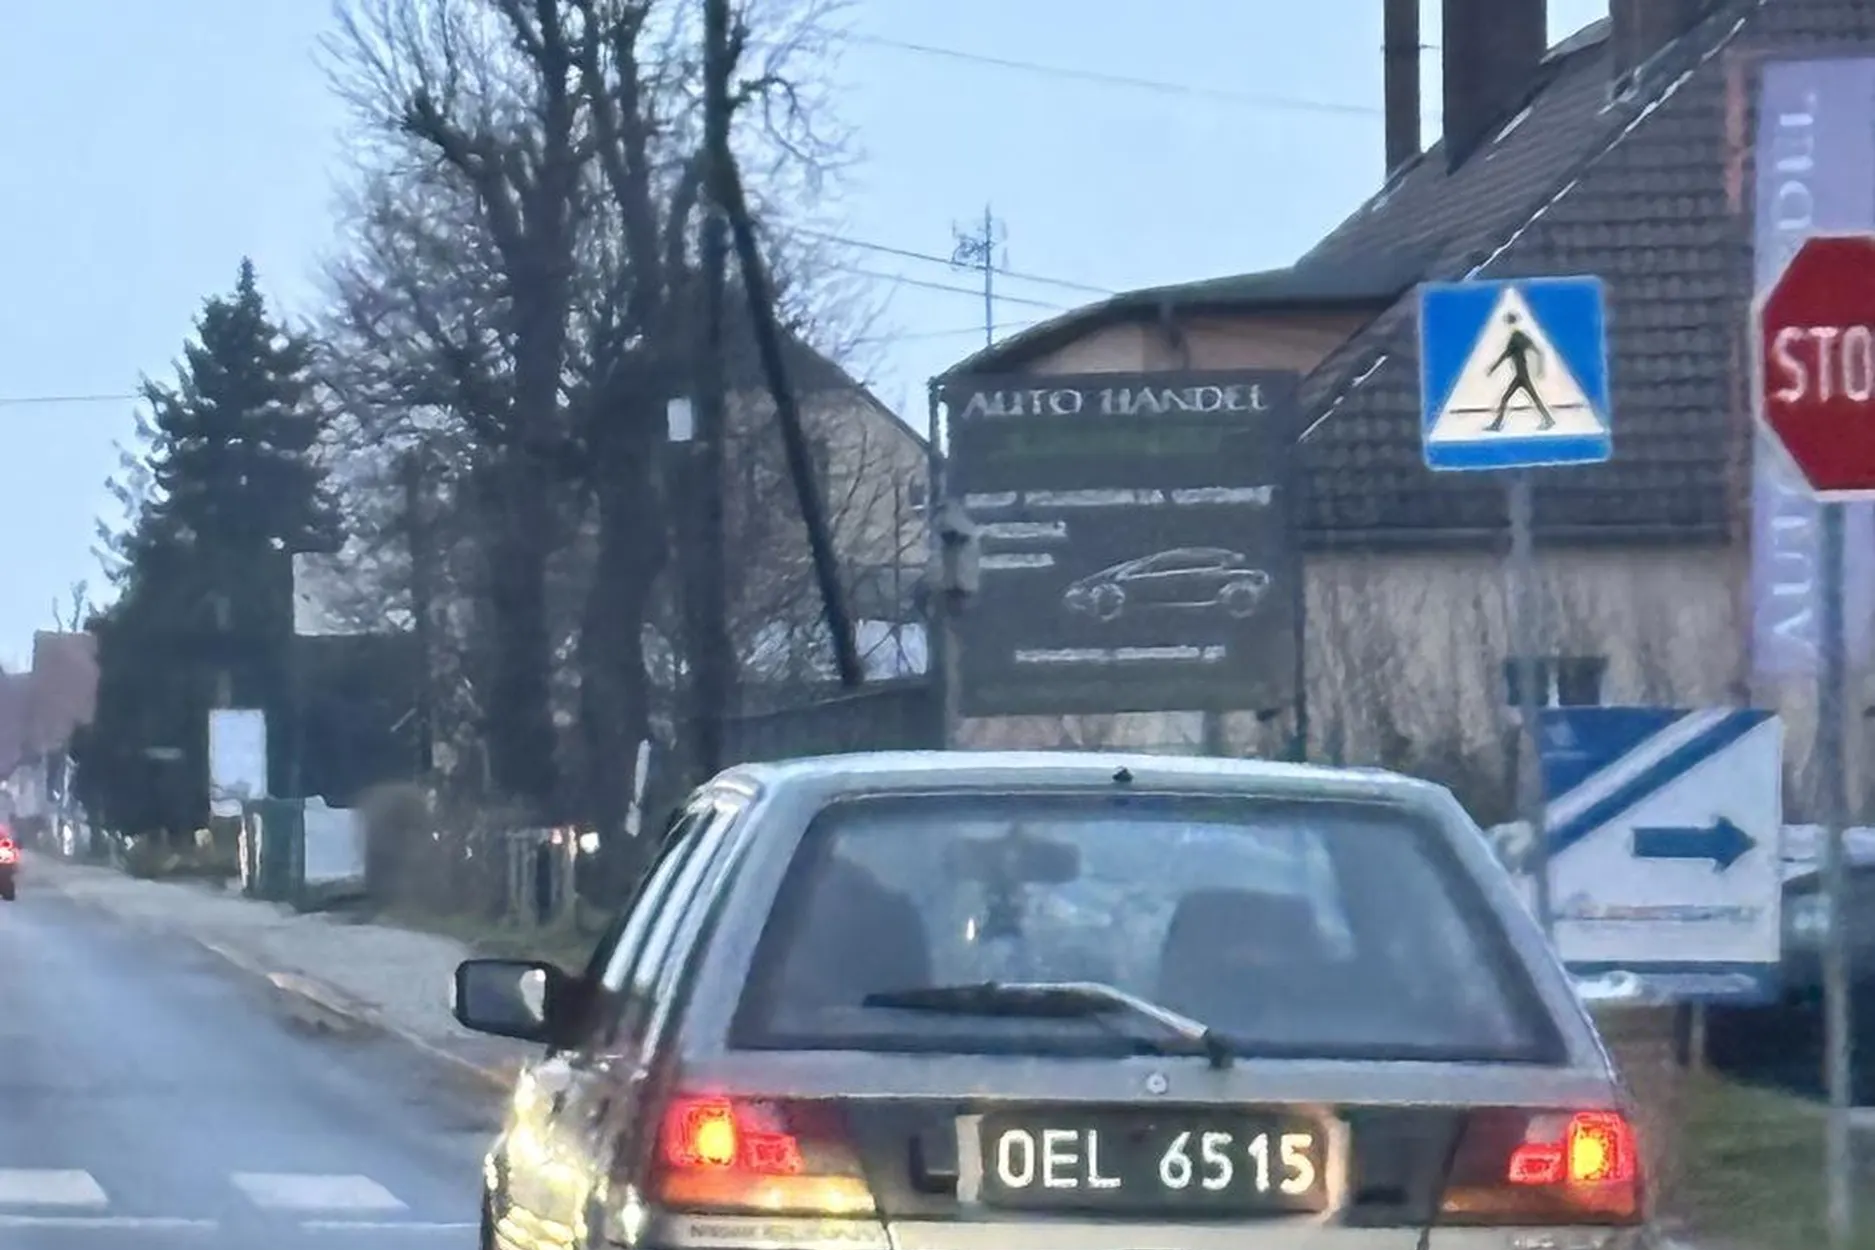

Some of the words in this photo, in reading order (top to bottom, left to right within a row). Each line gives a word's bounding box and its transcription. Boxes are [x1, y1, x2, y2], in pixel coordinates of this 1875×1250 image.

[1771, 325, 1874, 402] STO
[961, 388, 1083, 420] AUTO
[998, 1129, 1121, 1188] OEL
[1159, 1131, 1315, 1195] 6515
